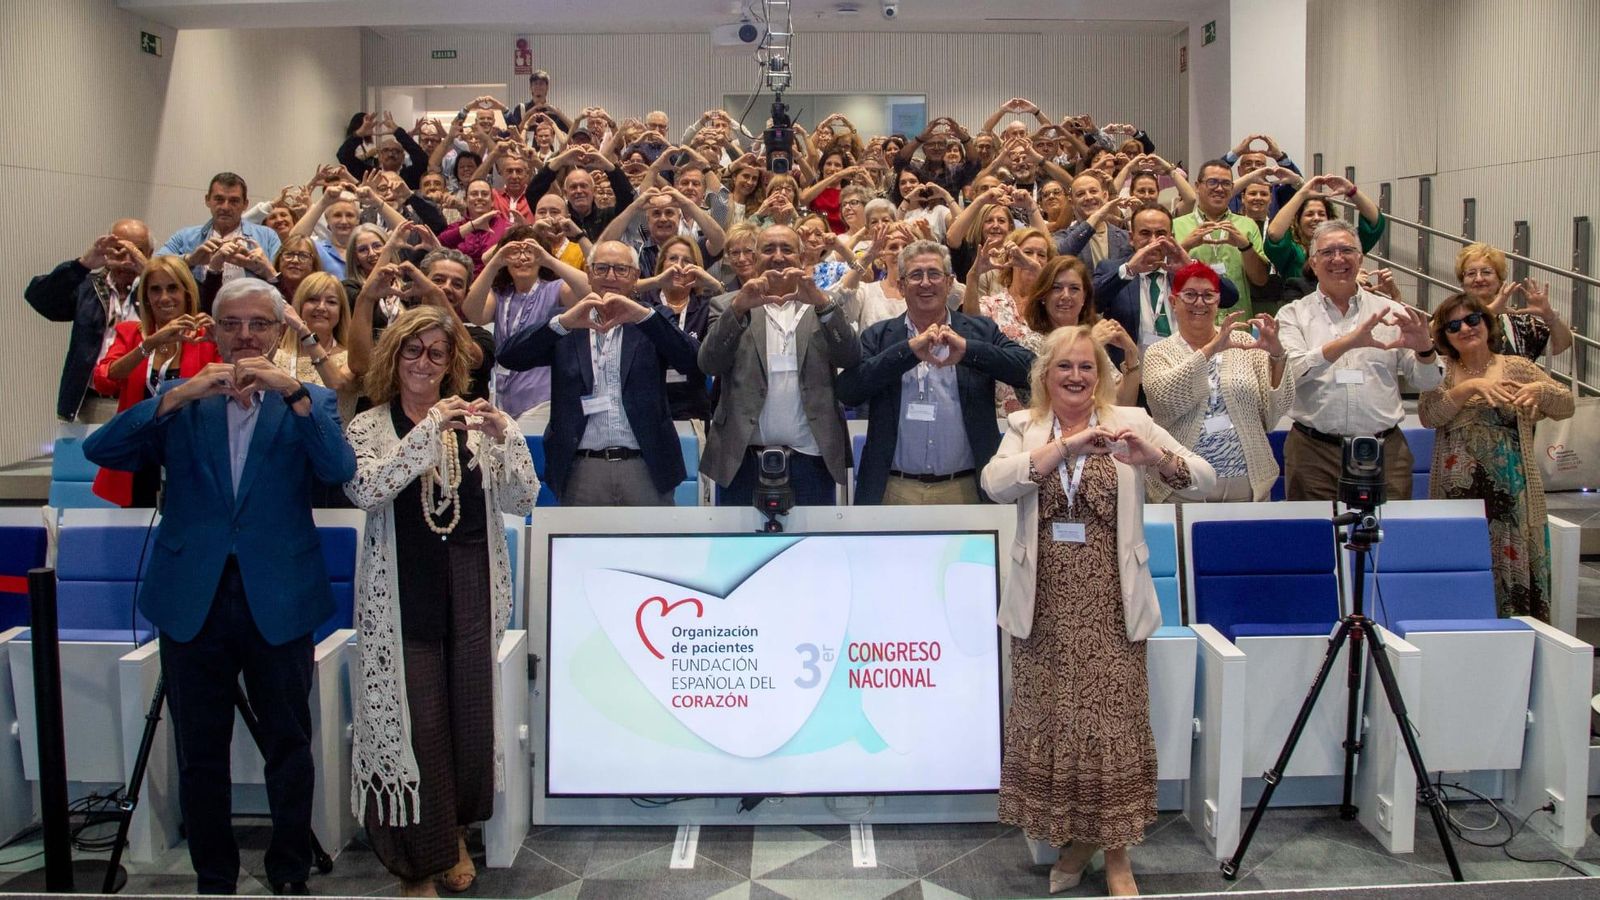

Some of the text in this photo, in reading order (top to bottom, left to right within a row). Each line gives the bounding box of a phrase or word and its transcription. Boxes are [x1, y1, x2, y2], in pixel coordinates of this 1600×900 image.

[671, 625, 759, 640] Organización
[671, 642, 754, 656] de pacientes
[848, 641, 941, 662] CONGRESO
[671, 656, 758, 671] FUNDACIÓN
[794, 642, 822, 689] 3
[671, 674, 776, 690] ESPAÑOLA DEL
[849, 668, 936, 688] NACIONAL
[671, 692, 748, 708] CORAZÓN
